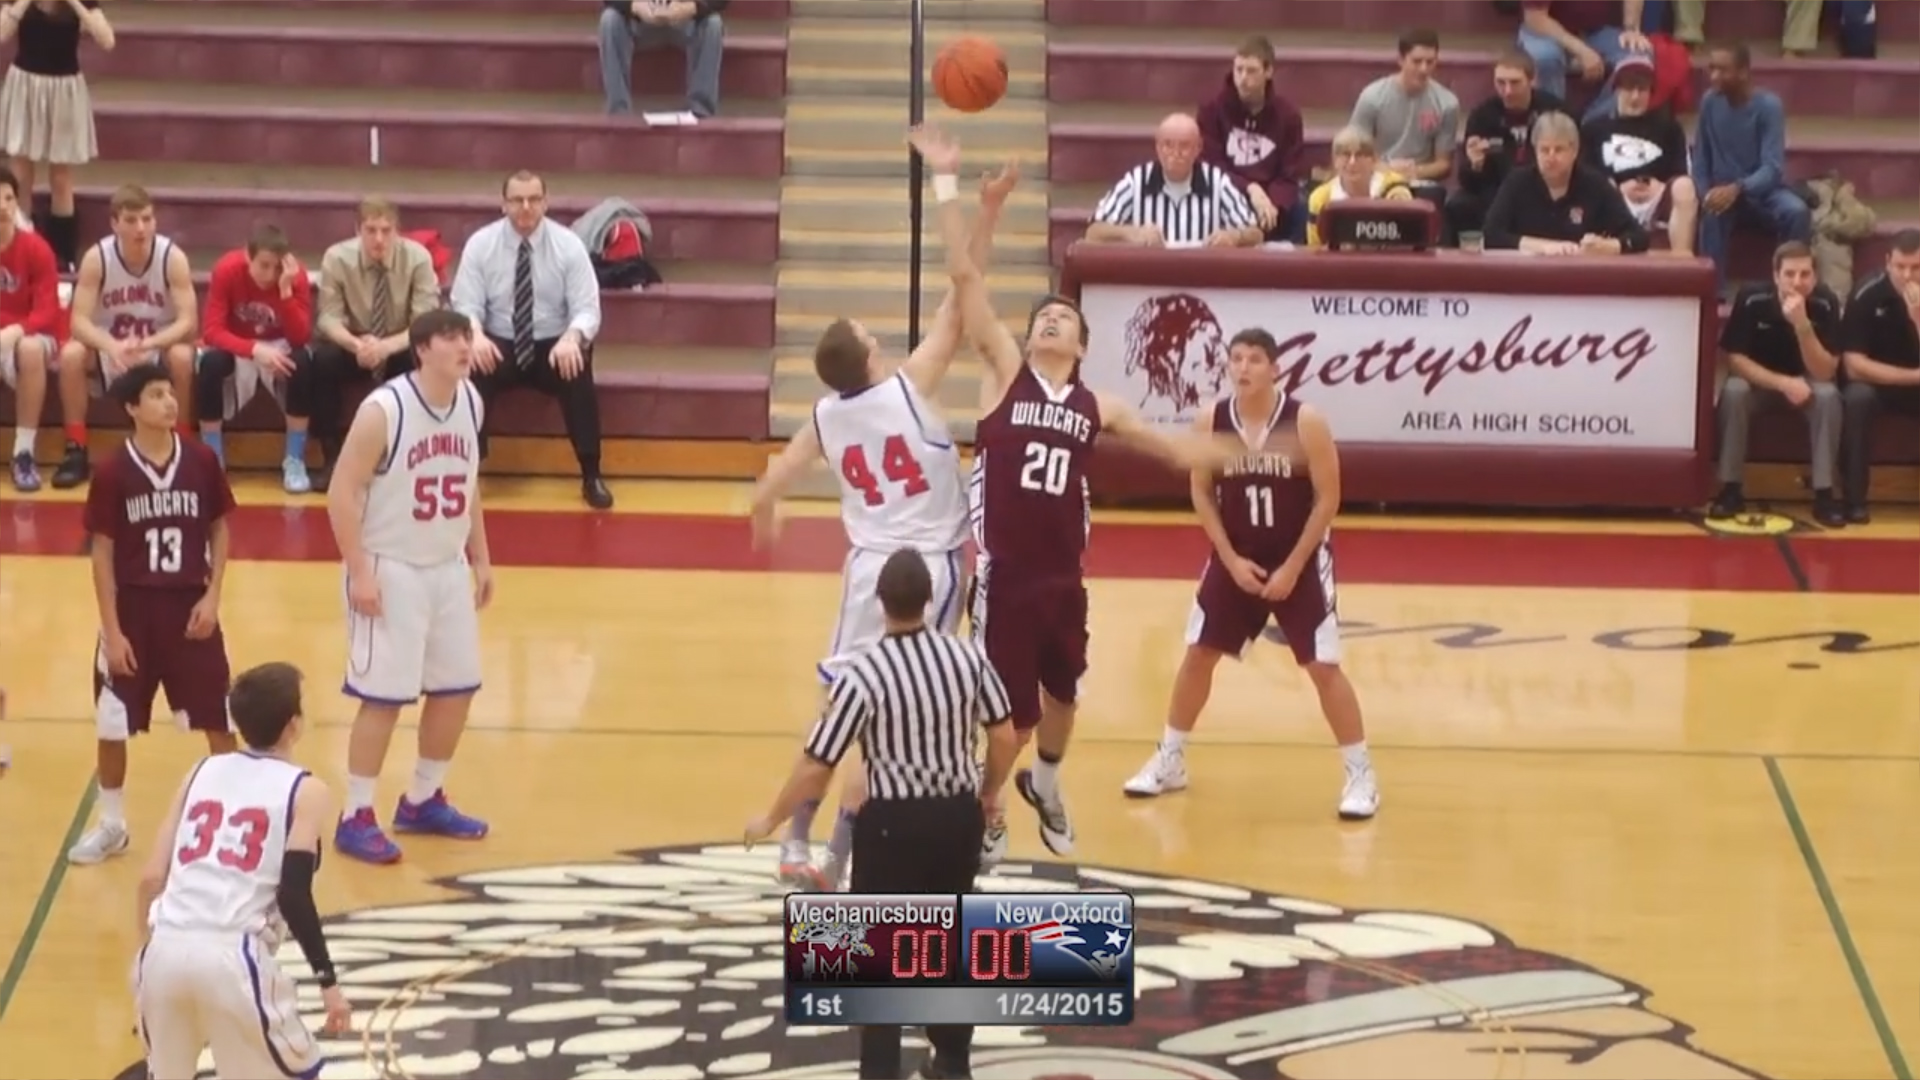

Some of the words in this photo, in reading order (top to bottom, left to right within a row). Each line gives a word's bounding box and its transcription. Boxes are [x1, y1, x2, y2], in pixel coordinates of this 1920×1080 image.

[1355, 221, 1402, 241] POSS.
[1311, 295, 1430, 318] WELCOME
[1440, 298, 1470, 318] TO
[1274, 313, 1659, 398] Gettysburg
[1010, 400, 1093, 444] WILDCATS
[1401, 411, 1462, 431] AREA
[1472, 413, 1528, 434] HIGH
[1537, 414, 1635, 436] SCHOOL
[841, 433, 932, 507] 44
[1019, 441, 1072, 496] 20
[125, 489, 199, 524] WILDCATS
[411, 474, 468, 522] 55
[1244, 484, 1275, 528] 11
[144, 526, 183, 573] 13
[177, 798, 271, 873] 33
